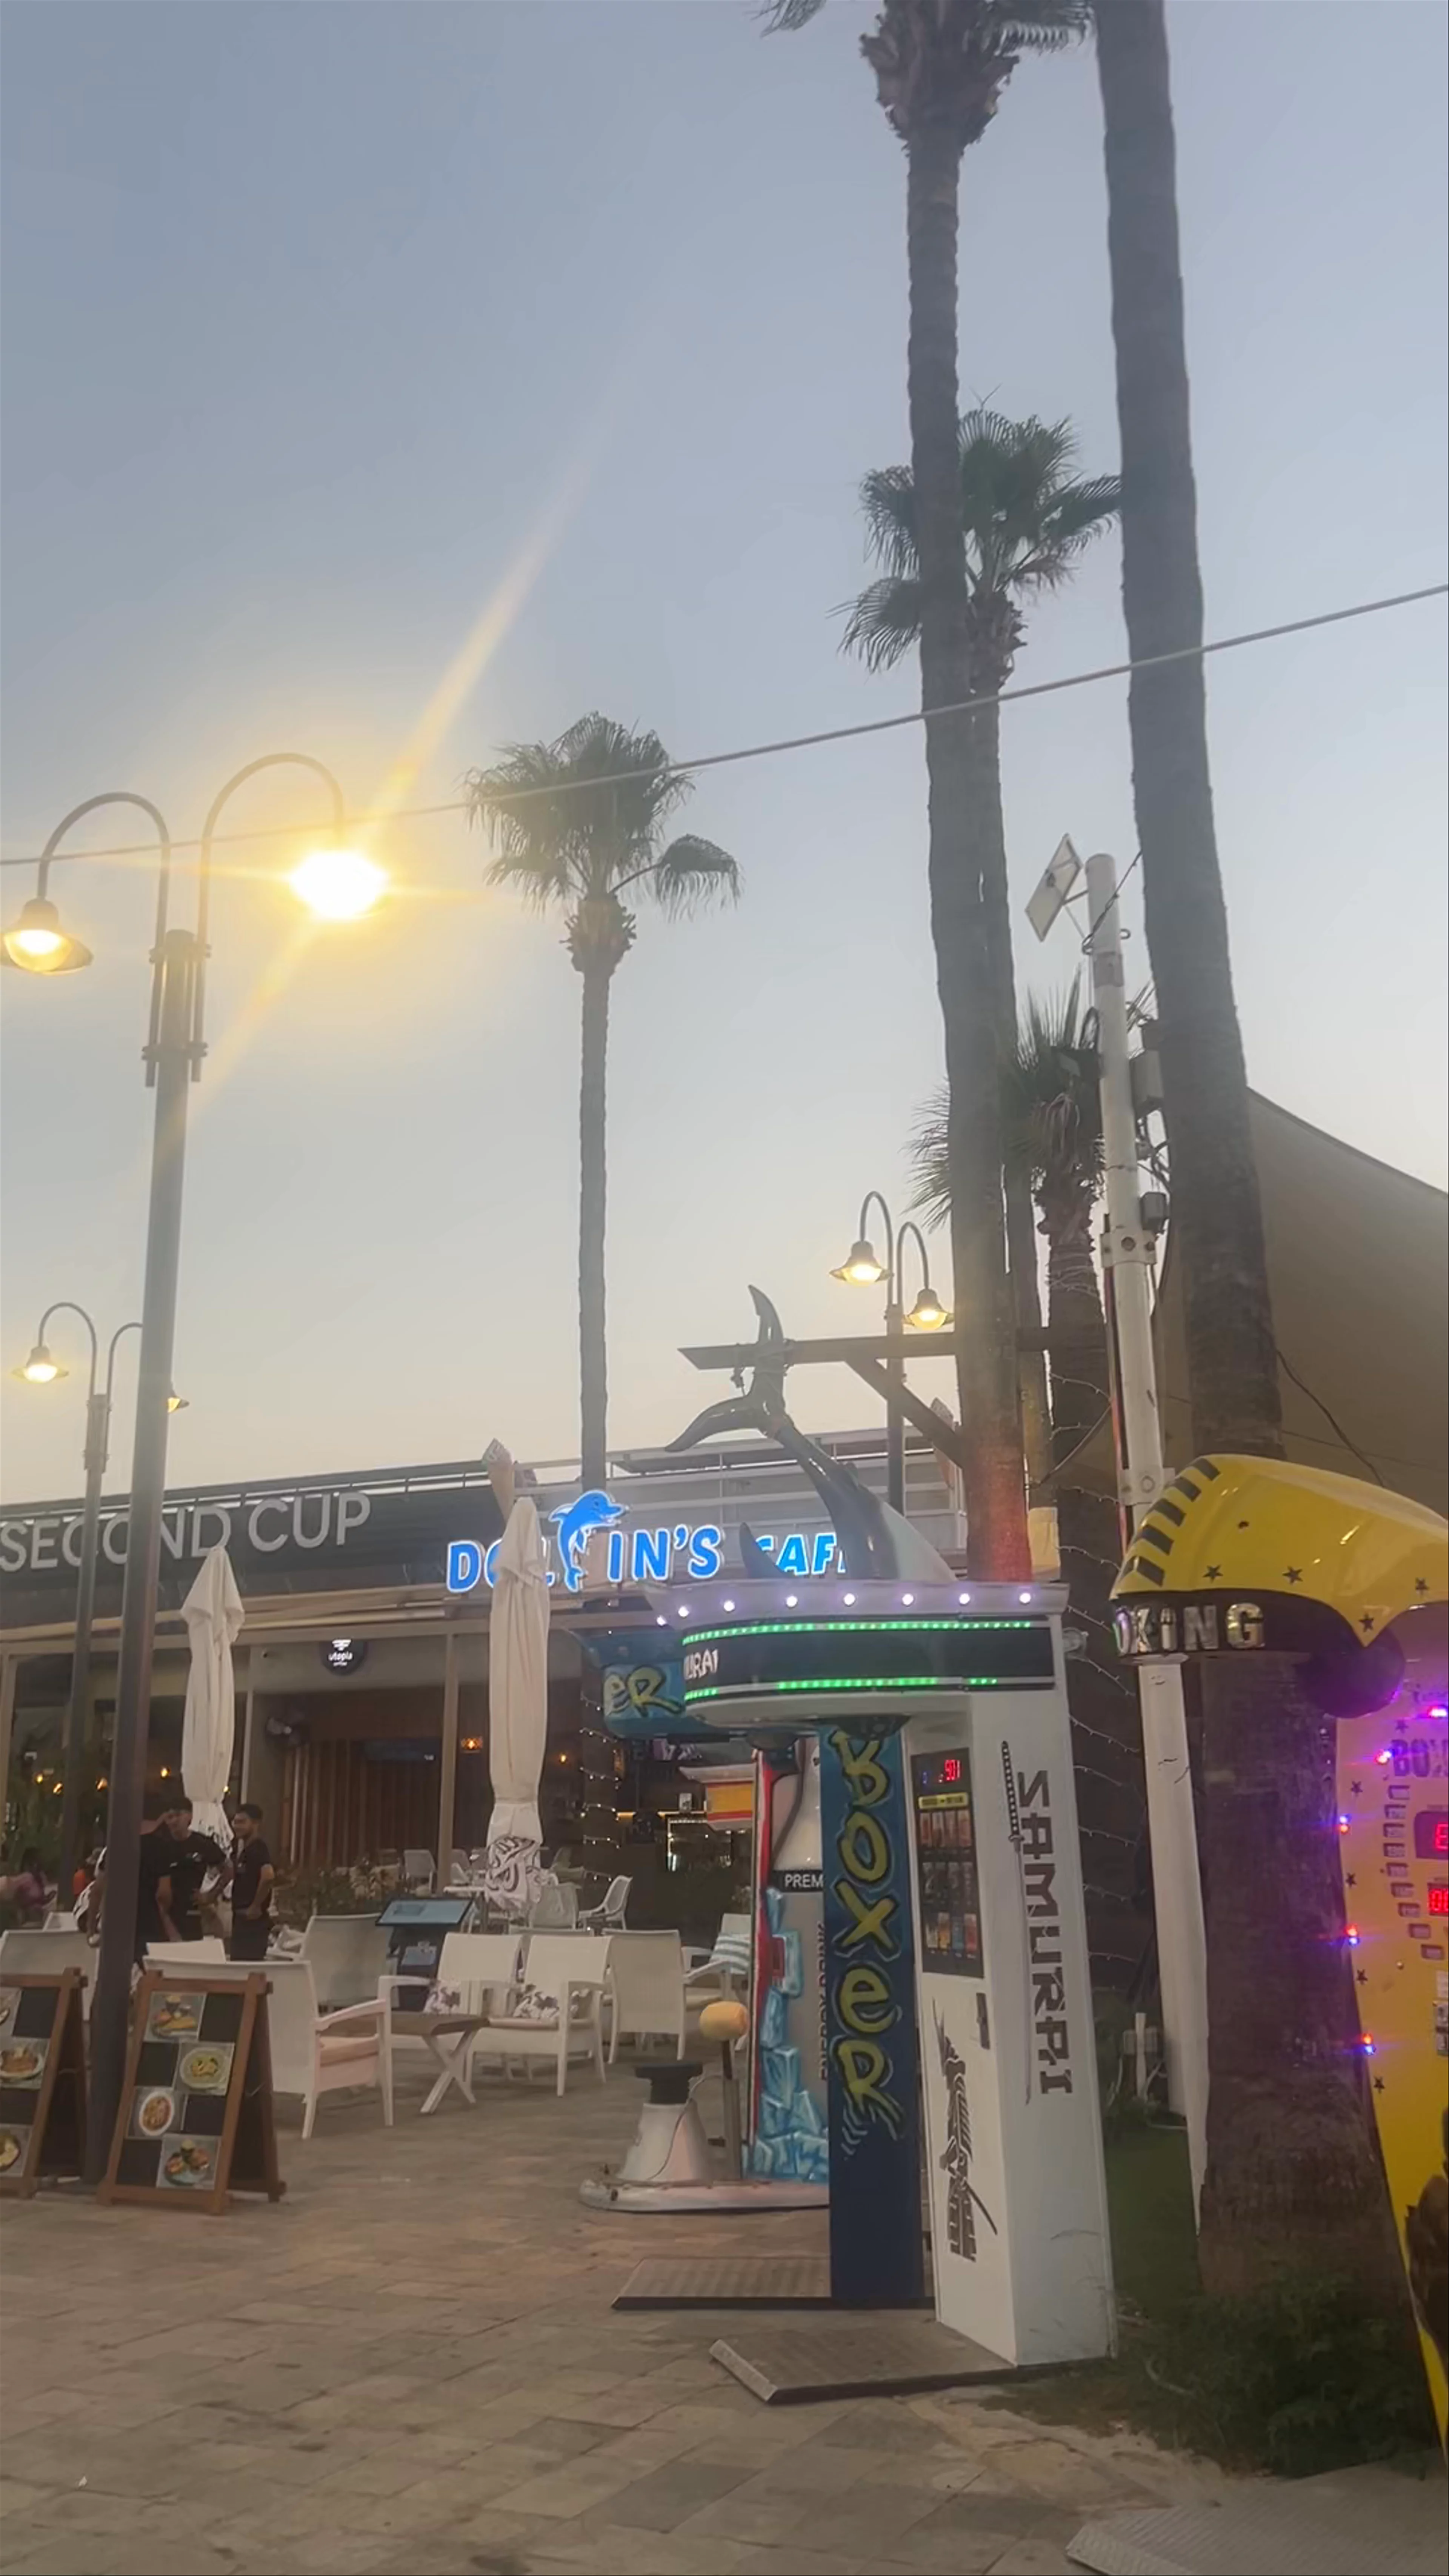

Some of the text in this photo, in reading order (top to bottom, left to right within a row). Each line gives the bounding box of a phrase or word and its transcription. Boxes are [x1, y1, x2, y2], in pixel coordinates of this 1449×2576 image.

[248, 1492, 371, 1552] CUP
[785, 1873, 823, 1888] PREM
[1017, 1770, 1073, 2094] SAMURAI
